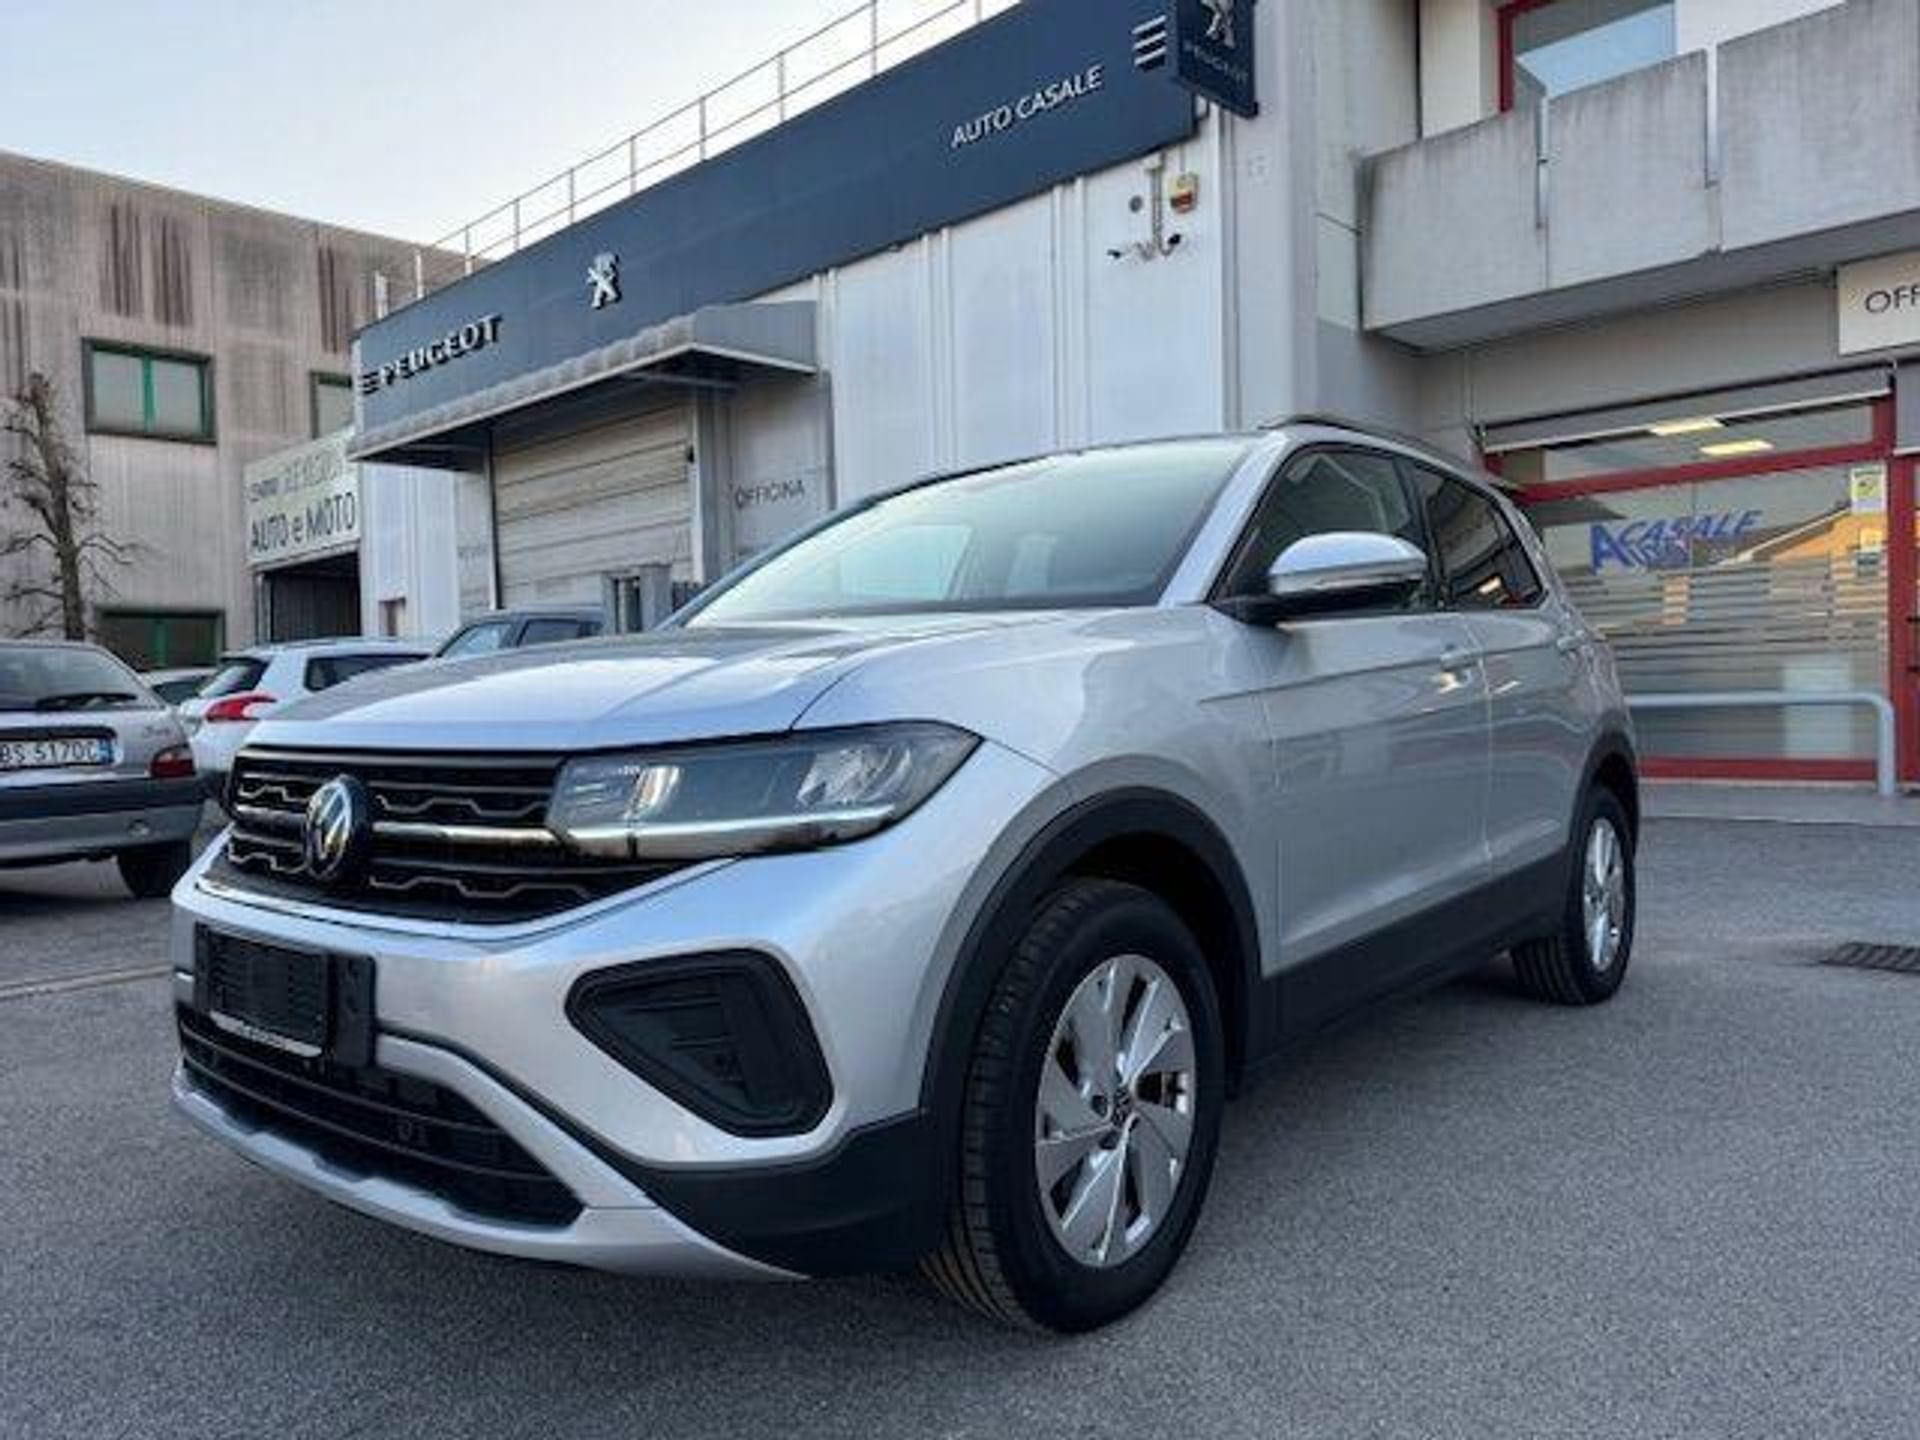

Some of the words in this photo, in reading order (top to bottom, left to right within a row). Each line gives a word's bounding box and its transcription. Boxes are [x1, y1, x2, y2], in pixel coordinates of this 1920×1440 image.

[951, 105, 1013, 149] AUTO
[1016, 64, 1103, 120] CASALE
[380, 313, 502, 386] PEUGEOT
[251, 512, 289, 552] AUTO
[306, 491, 356, 541] MOTO
[735, 480, 806, 510] OFFICINA
